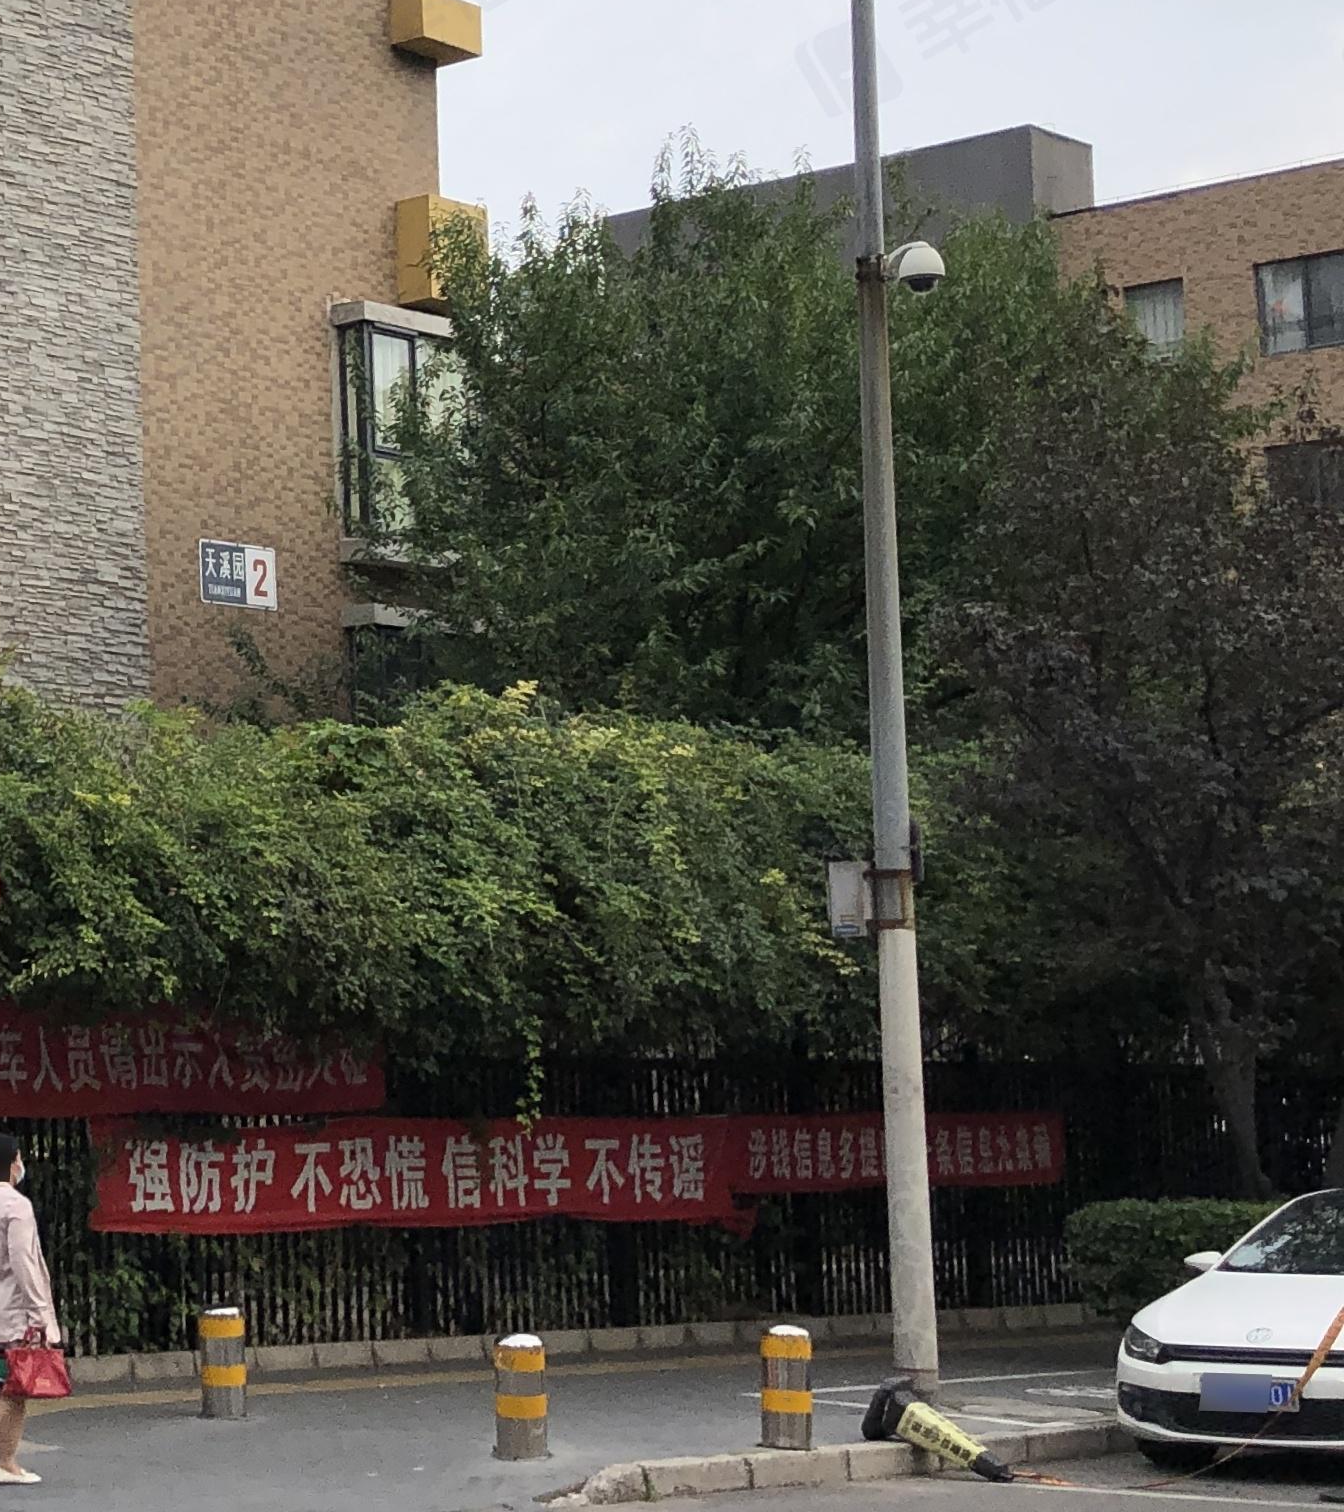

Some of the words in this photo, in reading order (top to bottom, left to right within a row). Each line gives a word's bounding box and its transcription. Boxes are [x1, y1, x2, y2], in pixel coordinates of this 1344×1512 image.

[205, 548, 245, 582] 天溪园
[253, 558, 268, 598] 2
[128, 1135, 277, 1213] 强防护
[289, 1136, 429, 1213] 不恐慌
[441, 1132, 572, 1209] 信科学
[585, 1133, 706, 1204] 不传谣
